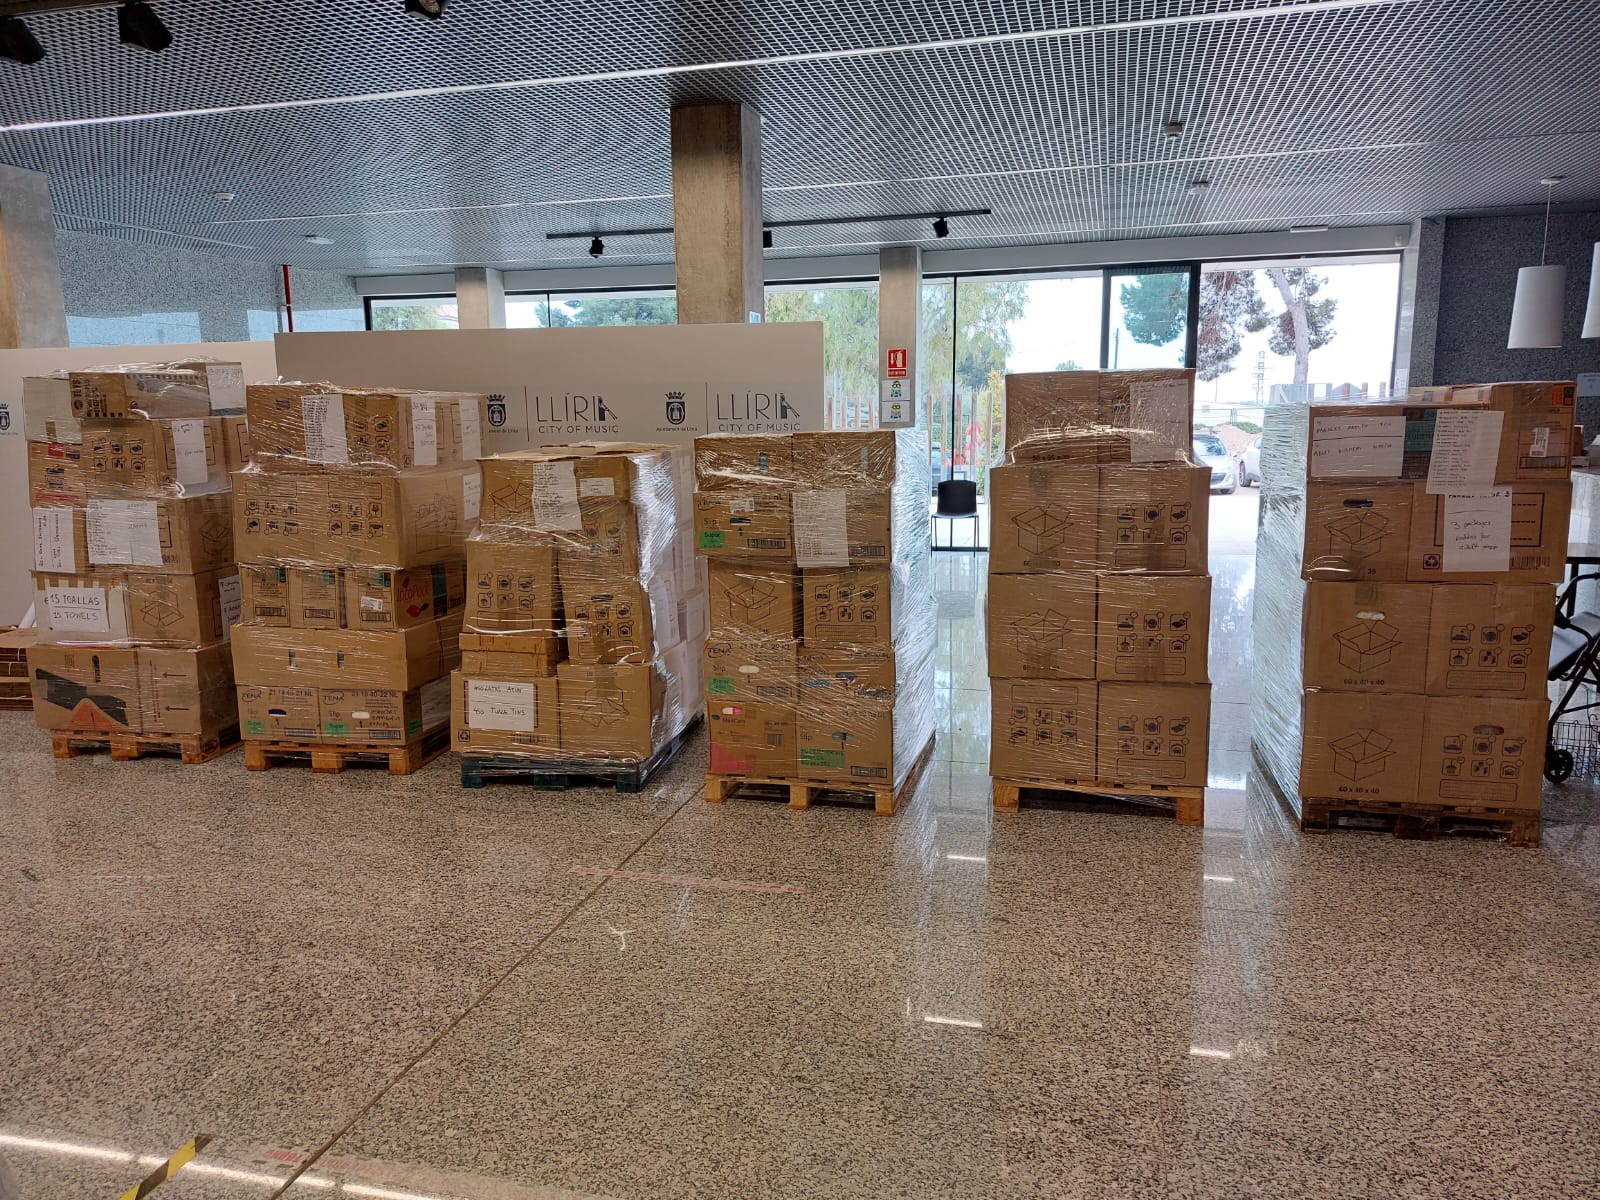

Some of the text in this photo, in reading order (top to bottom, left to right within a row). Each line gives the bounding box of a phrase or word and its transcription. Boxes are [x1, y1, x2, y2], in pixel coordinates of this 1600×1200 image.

[538, 425, 619, 434] CITY OF MUSIC
[718, 423, 801, 432] CITY OF MUSIC
[1451, 521, 1460, 530] 3
[50, 594, 60, 604] 15
[63, 595, 100, 606] TOALLAS
[64, 611, 98, 621] TOWELS
[707, 645, 732, 655] TENA
[800, 732, 813, 741] Slip
